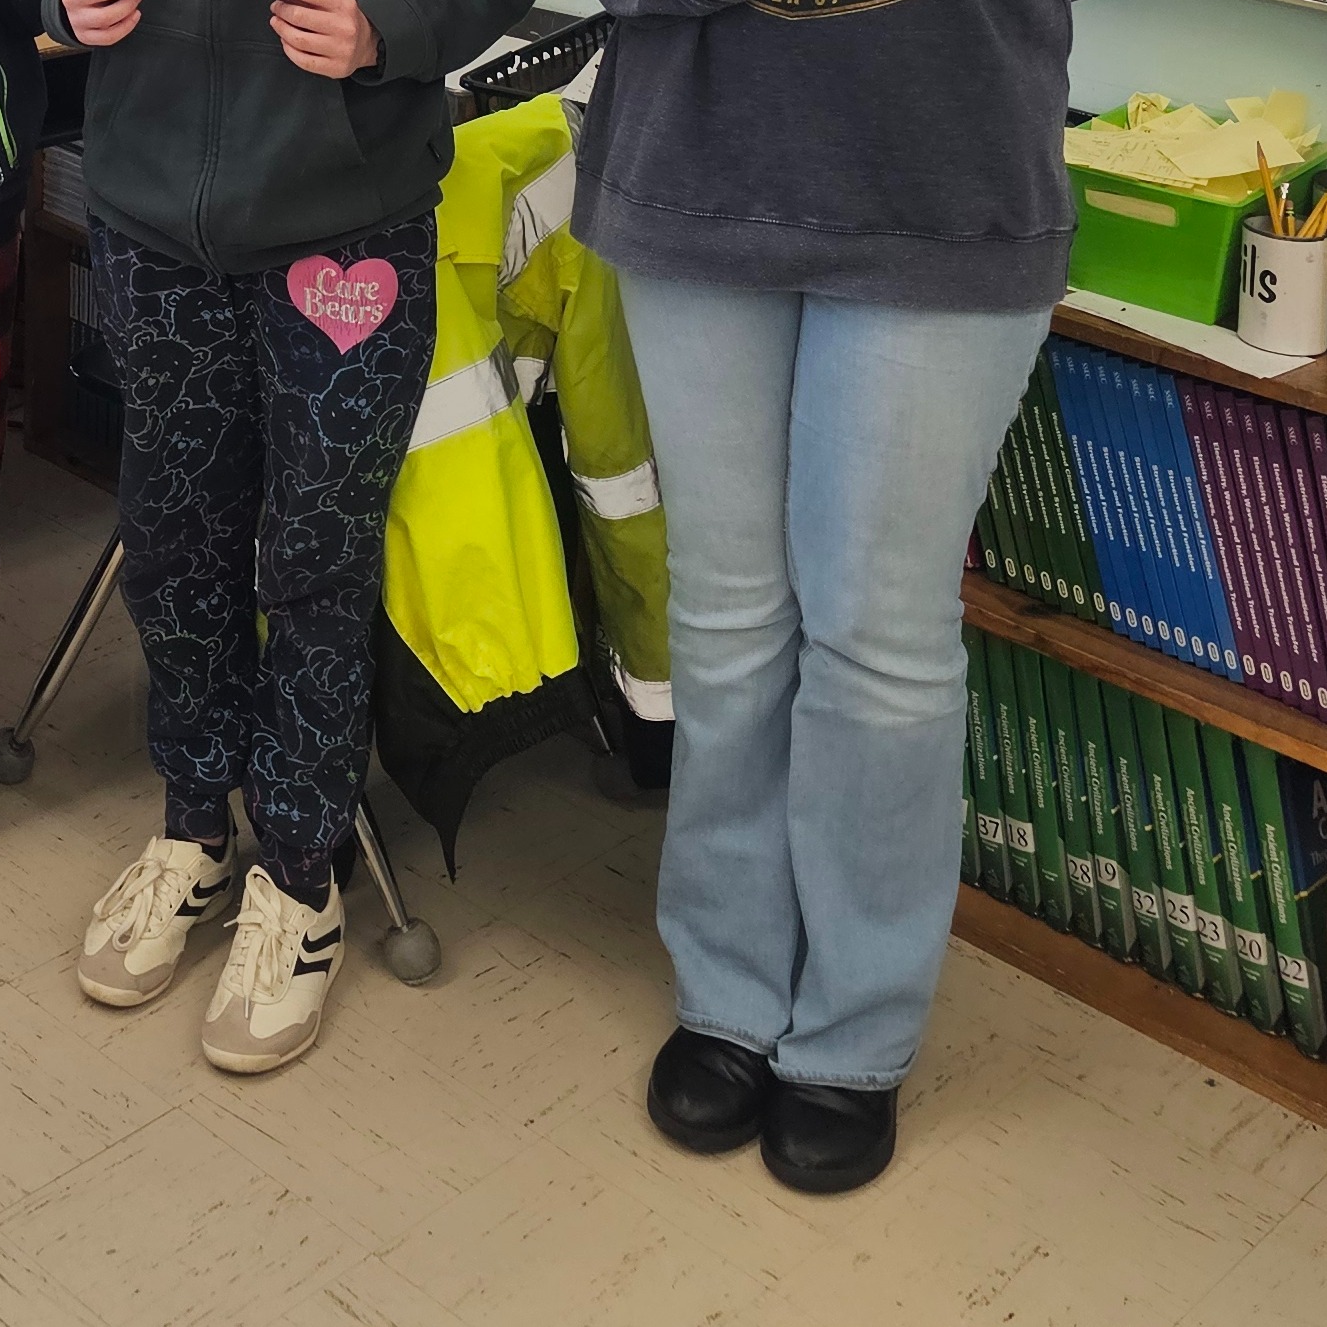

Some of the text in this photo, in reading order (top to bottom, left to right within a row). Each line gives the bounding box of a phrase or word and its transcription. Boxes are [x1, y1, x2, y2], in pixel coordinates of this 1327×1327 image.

[316, 268, 380, 300] Care
[303, 287, 384, 324] Bears
[1086, 440, 1114, 541] Structure Function
[1134, 456, 1163, 558] Structure Function
[978, 816, 1000, 839] 37
[1009, 822, 1028, 848] 18
[1070, 859, 1091, 884] 28
[1097, 858, 1117, 882] 19
[1264, 823, 1287, 925] Ancient Civilizations
[1133, 890, 1157, 916] 32
[1167, 898, 1190, 924] 25
[1197, 916, 1220, 942] 23
[1238, 933, 1262, 960] 20
[1279, 955, 1304, 981] 22
